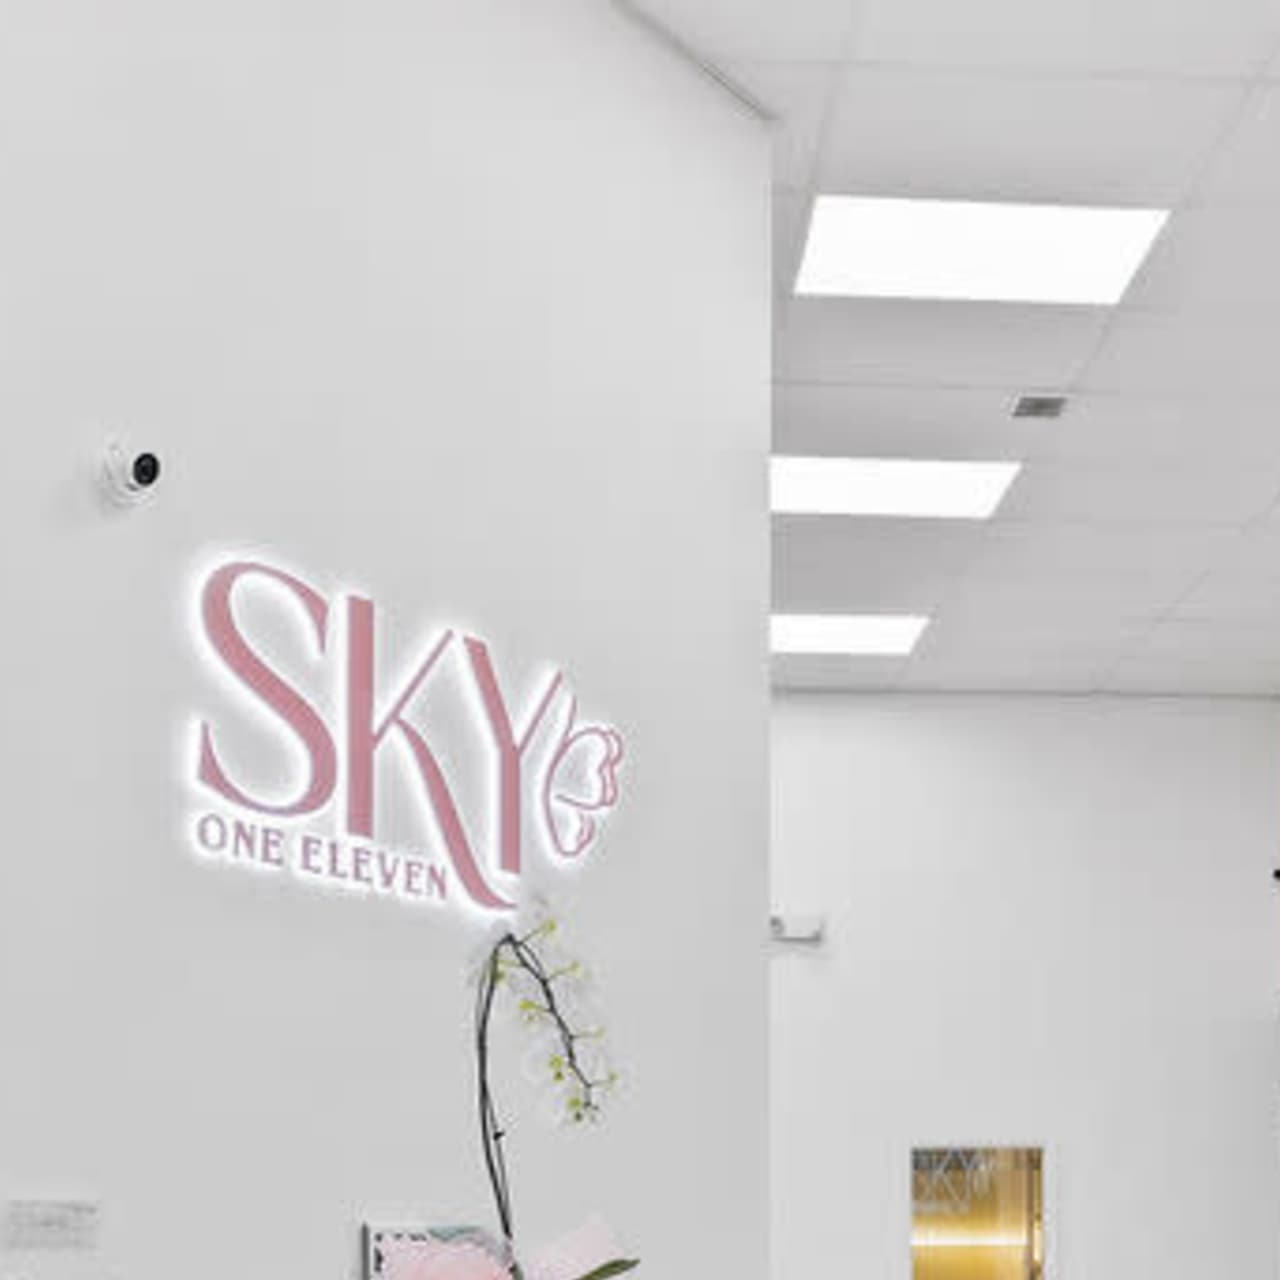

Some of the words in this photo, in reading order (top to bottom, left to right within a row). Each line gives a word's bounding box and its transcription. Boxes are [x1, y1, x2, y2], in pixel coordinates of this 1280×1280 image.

[197, 561, 562, 910] SKY
[197, 813, 285, 866] ONE
[300, 835, 448, 900] ELEVEN
